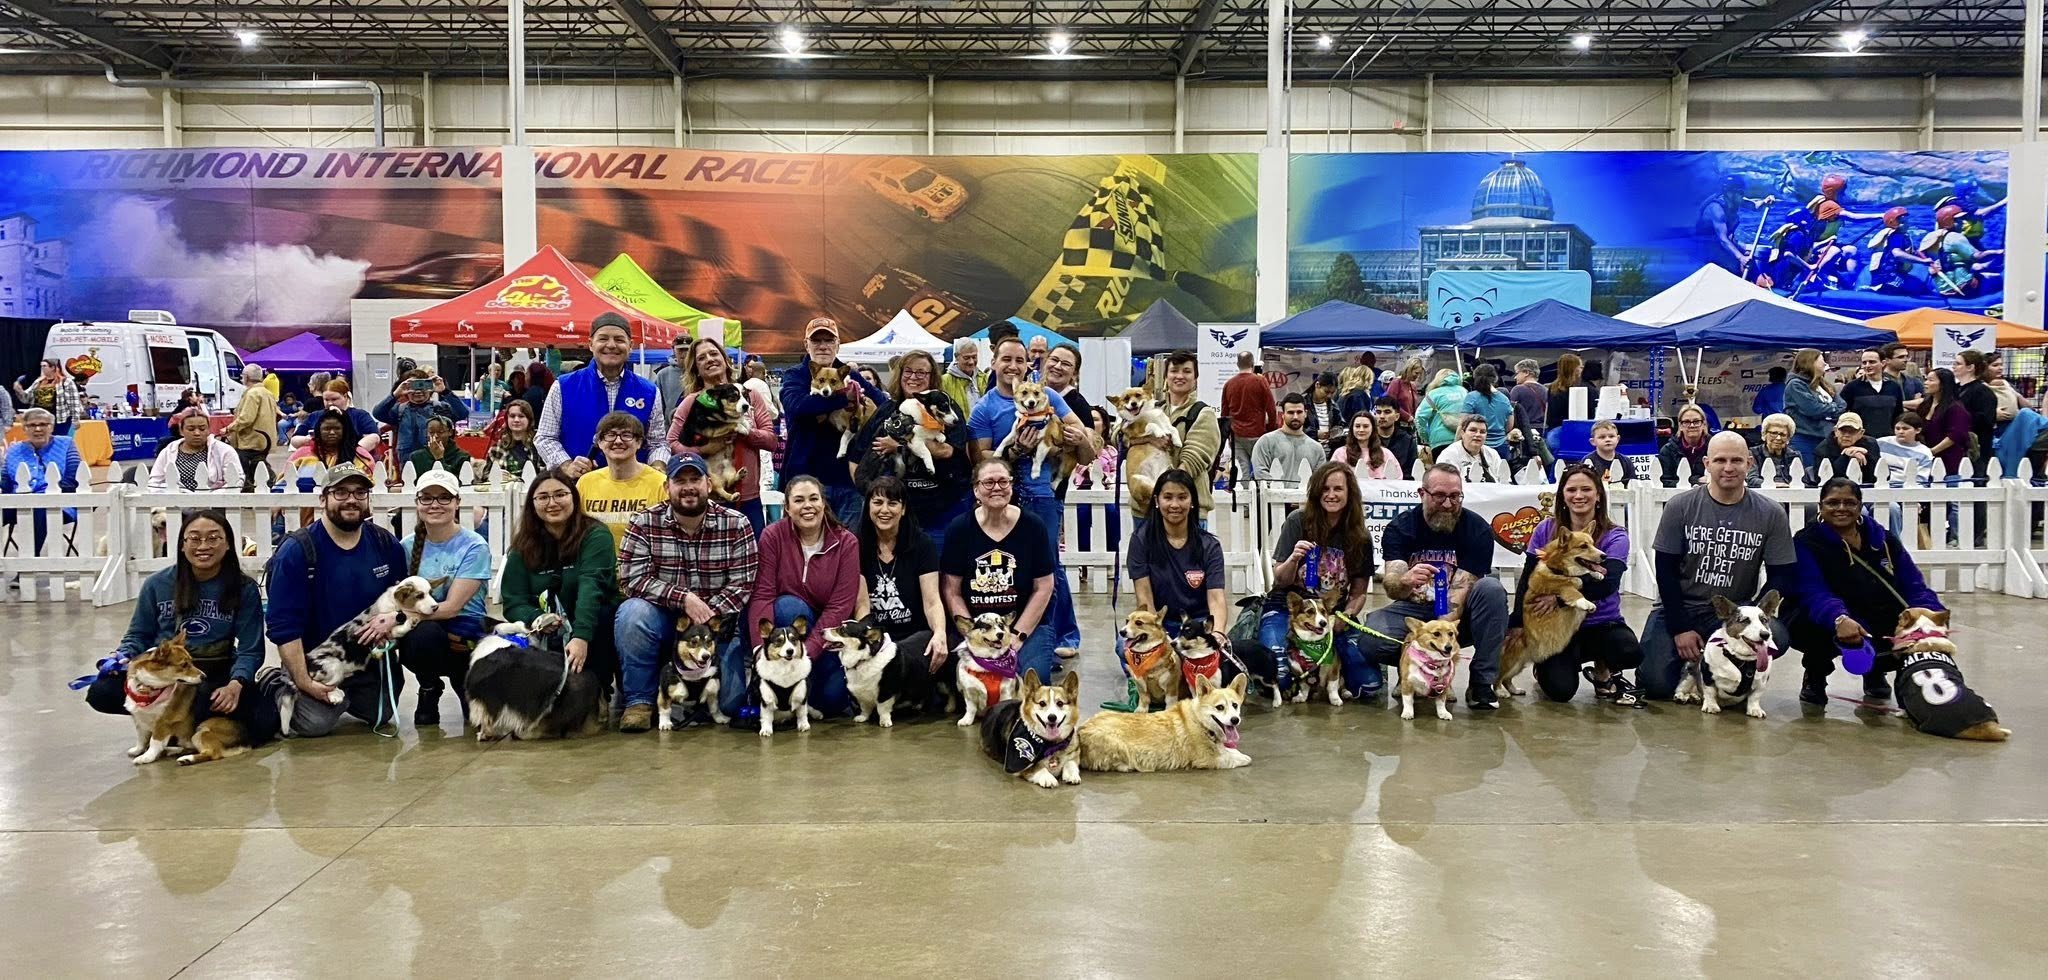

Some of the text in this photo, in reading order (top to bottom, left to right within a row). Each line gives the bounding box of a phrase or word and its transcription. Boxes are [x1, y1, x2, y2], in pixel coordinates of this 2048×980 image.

[77, 152, 308, 179] RICHMOND
[314, 152, 668, 180] INTERNAIONAL
[1629, 455, 1651, 463] EASE
[1380, 489, 1419, 499] Thanks
[585, 498, 648, 513] VCU RAMS
[1498, 513, 1541, 534] Aussie
[1700, 555, 1710, 571] A
[970, 594, 1018, 604] SPLOOTFEST
[1911, 668, 1960, 706] 8
